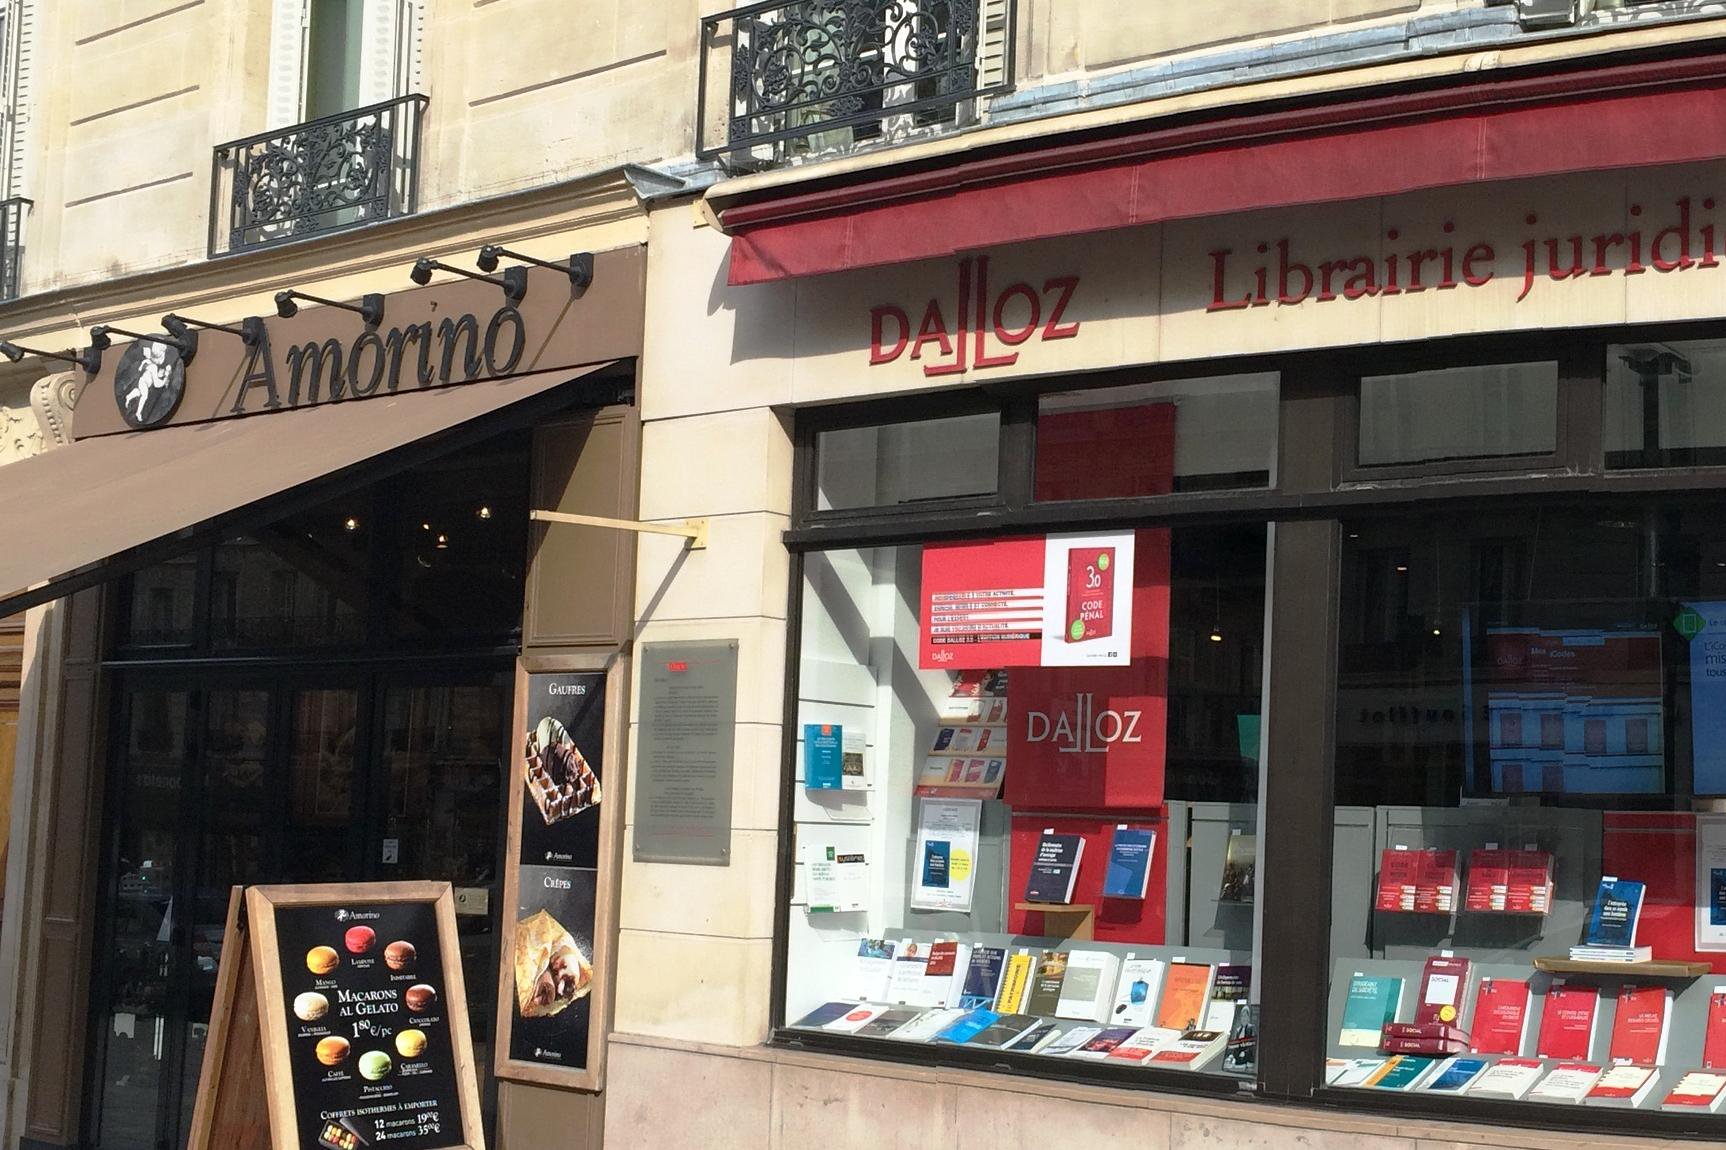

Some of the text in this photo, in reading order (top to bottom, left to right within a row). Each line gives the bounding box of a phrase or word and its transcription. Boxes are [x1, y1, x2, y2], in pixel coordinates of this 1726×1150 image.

[1205, 222, 1495, 312] Librairie
[869, 256, 1080, 376] DALLOZ
[230, 302, 526, 414] Amorino
[1081, 600, 1103, 611] CODE
[1080, 609, 1104, 621] PÉNAL
[1705, 652, 1726, 664] mis
[1706, 668, 1726, 677] tous
[548, 682, 586, 696] GAUFRES
[1027, 692, 1143, 752] DALLOZ
[544, 876, 572, 890] CRÊPES
[349, 909, 380, 920] Amorino
[337, 989, 398, 1004] MACARONS
[339, 1001, 399, 1017] AL GELATO
[1405, 1026, 1422, 1034] SOCIAL
[1403, 1041, 1421, 1049] SOCIAL
[320, 1108, 355, 1120] COFFRETS
[356, 1104, 397, 1116] ISOTHERMES
[404, 1099, 438, 1110] EMPORTER
[374, 1118, 385, 1130] 12
[385, 1118, 416, 1129] macarons
[375, 1131, 386, 1142] 24
[386, 1128, 417, 1139] macarons
